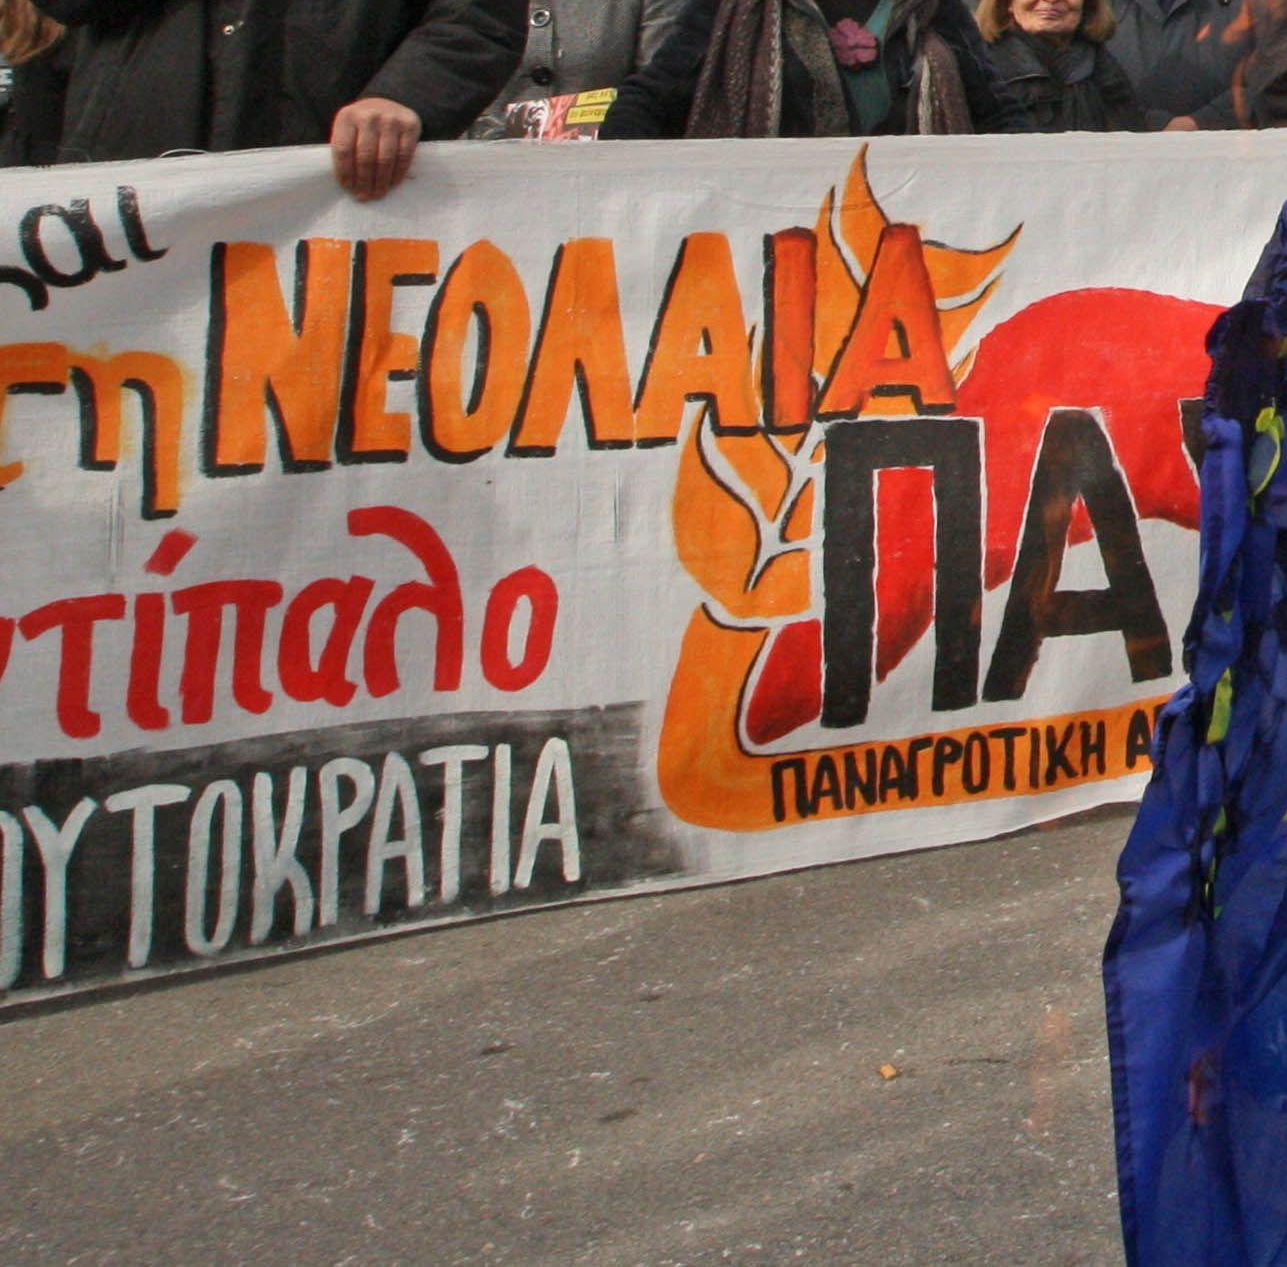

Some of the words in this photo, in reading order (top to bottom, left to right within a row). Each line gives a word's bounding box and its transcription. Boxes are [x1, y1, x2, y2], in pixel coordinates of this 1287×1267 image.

[203, 223, 957, 476] ΝΕΟΛΑΙΑ
[0, 505, 559, 738] τίπαλο
[820, 404, 1204, 729] ΠΑ
[771, 719, 1106, 822] ΠΑΝΑΓΡΟΤΙΚΗ
